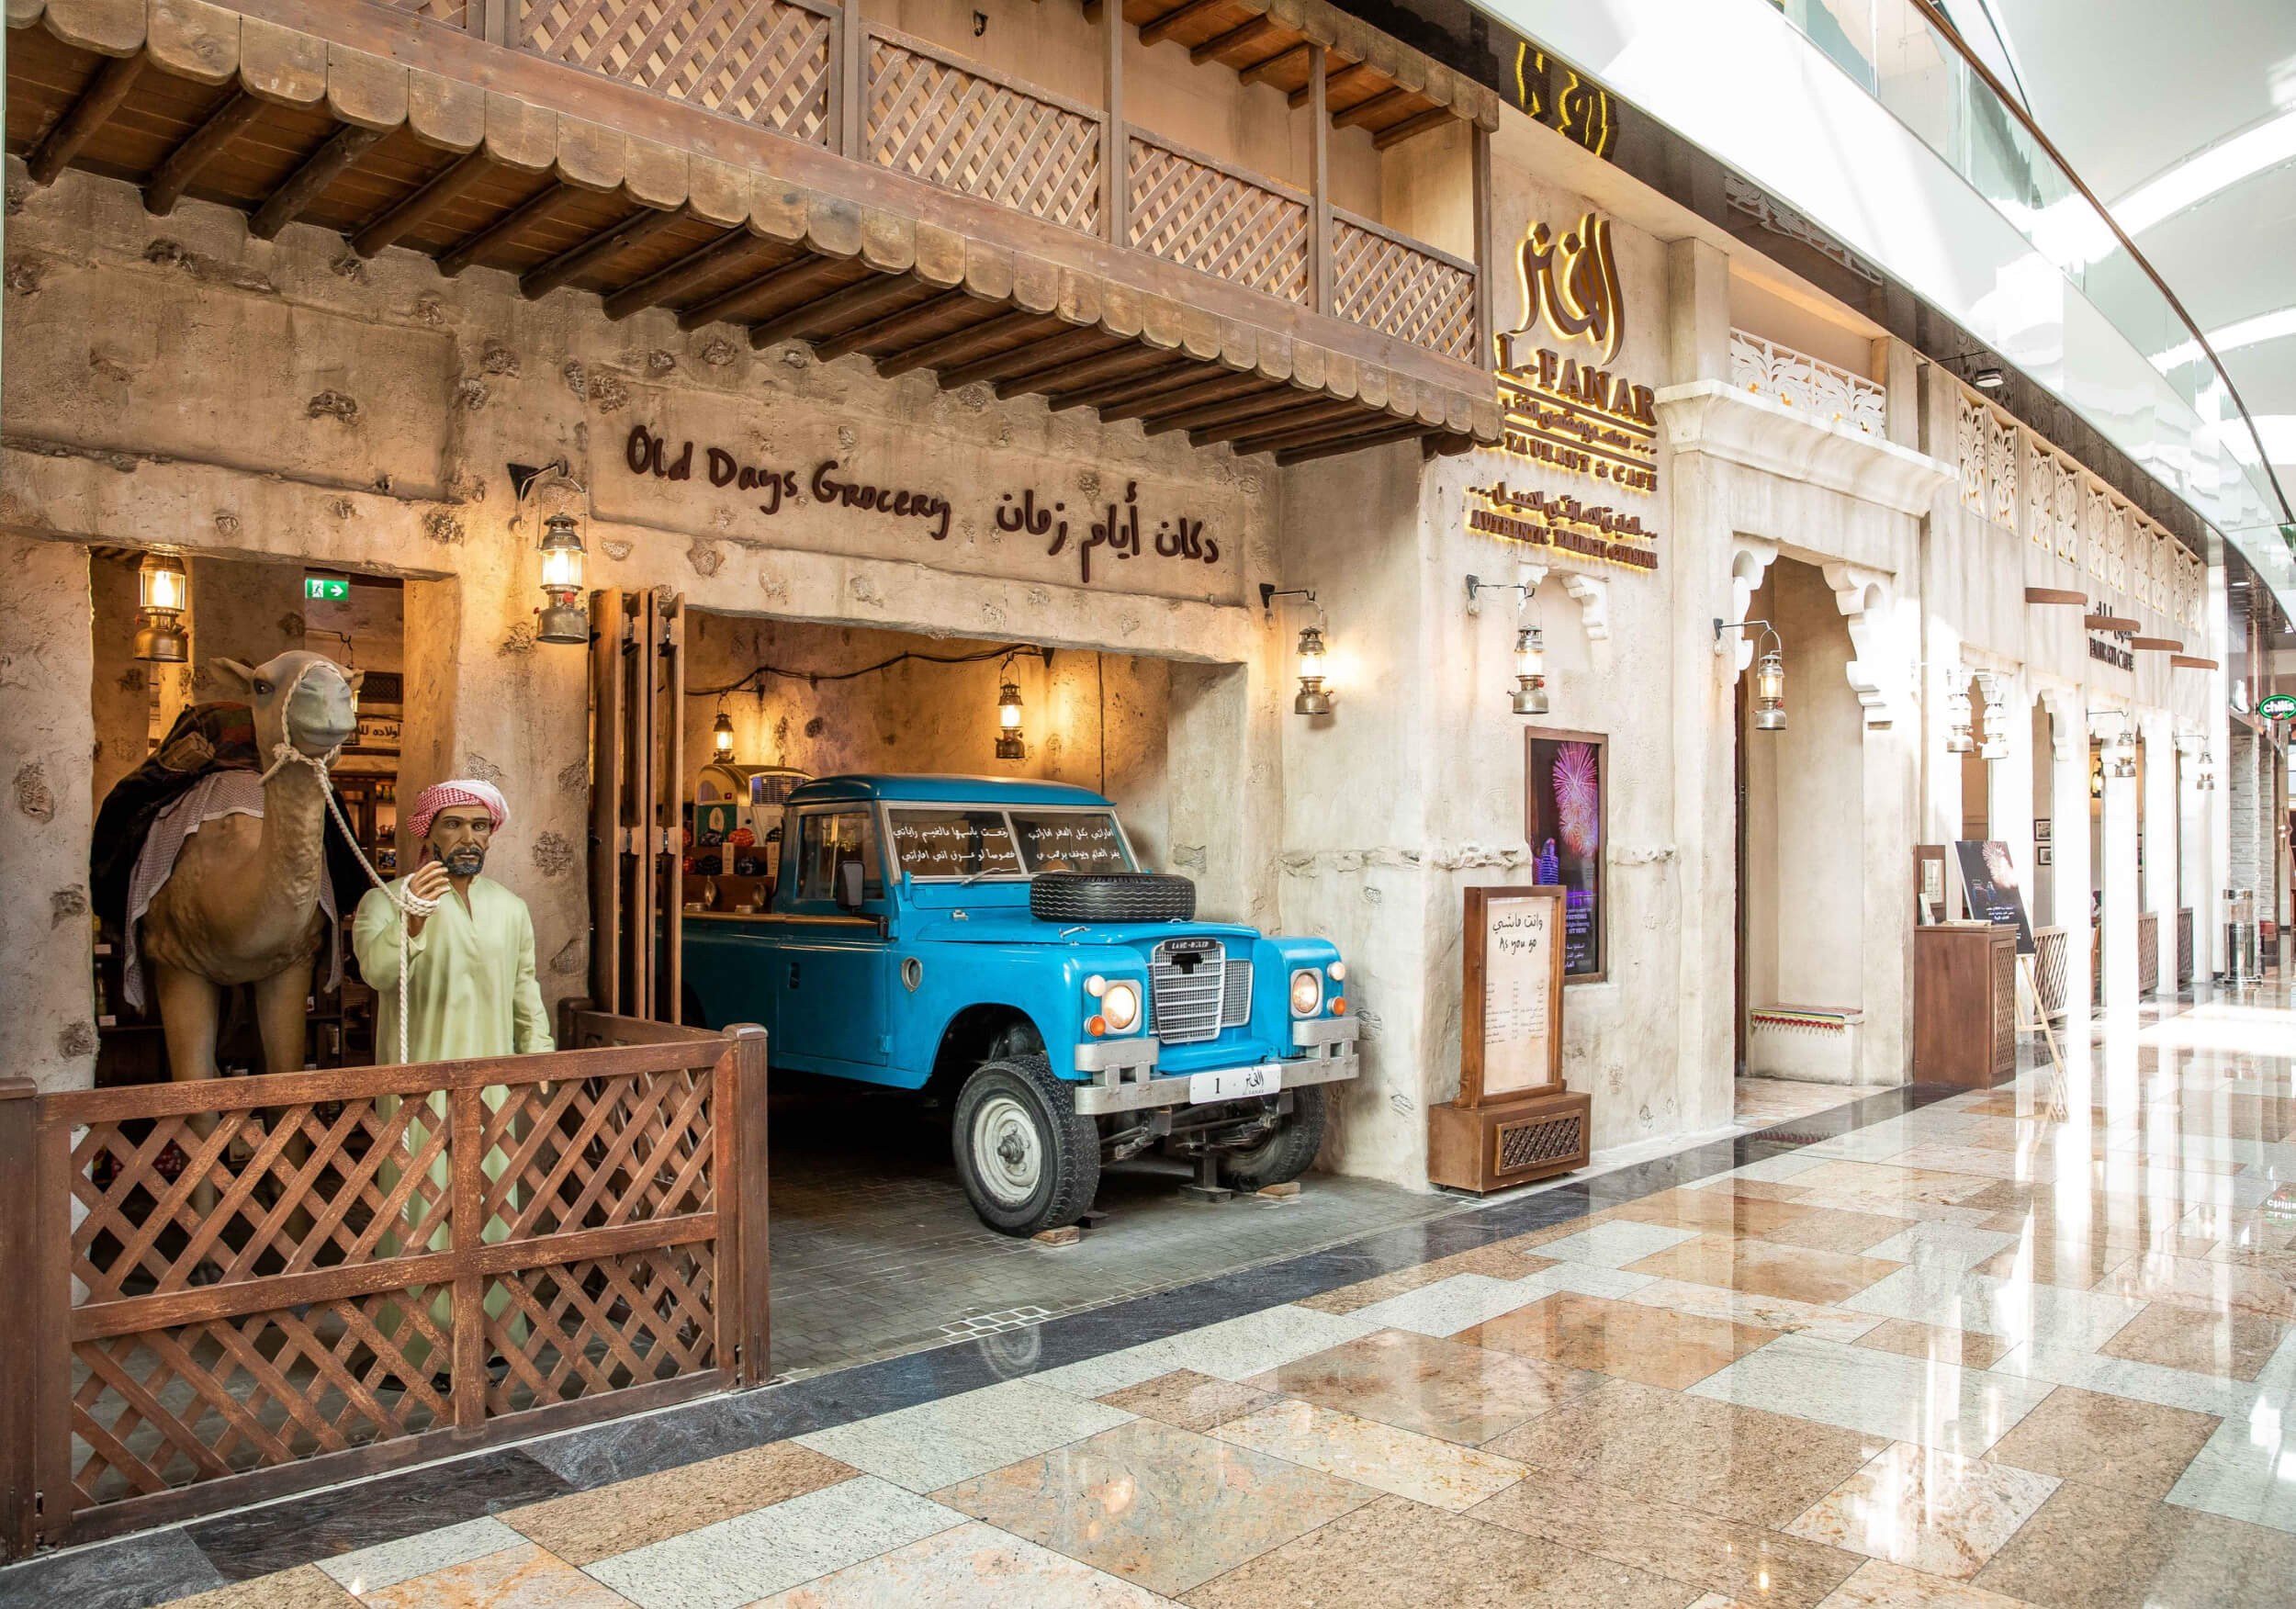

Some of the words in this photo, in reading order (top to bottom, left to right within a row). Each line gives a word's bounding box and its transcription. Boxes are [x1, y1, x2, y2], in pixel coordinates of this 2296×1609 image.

[1494, 332, 1658, 426] L-FANAR
[627, 424, 692, 480] Old
[707, 446, 799, 514] Days
[813, 461, 951, 540] Grocery
[1595, 459, 1609, 478] &
[1613, 466, 1658, 491] CAFE
[996, 489, 1065, 556] زمان
[1080, 480, 1142, 583] أيام
[1154, 518, 1220, 564] دكان
[1469, 510, 1550, 546] AUTHENTIC
[1553, 528, 1607, 558] EMIRATI
[1607, 543, 1658, 569] CUISINE
[1500, 937, 1509, 951] As
[1511, 940, 1525, 956] you
[1528, 939, 1537, 953] go
